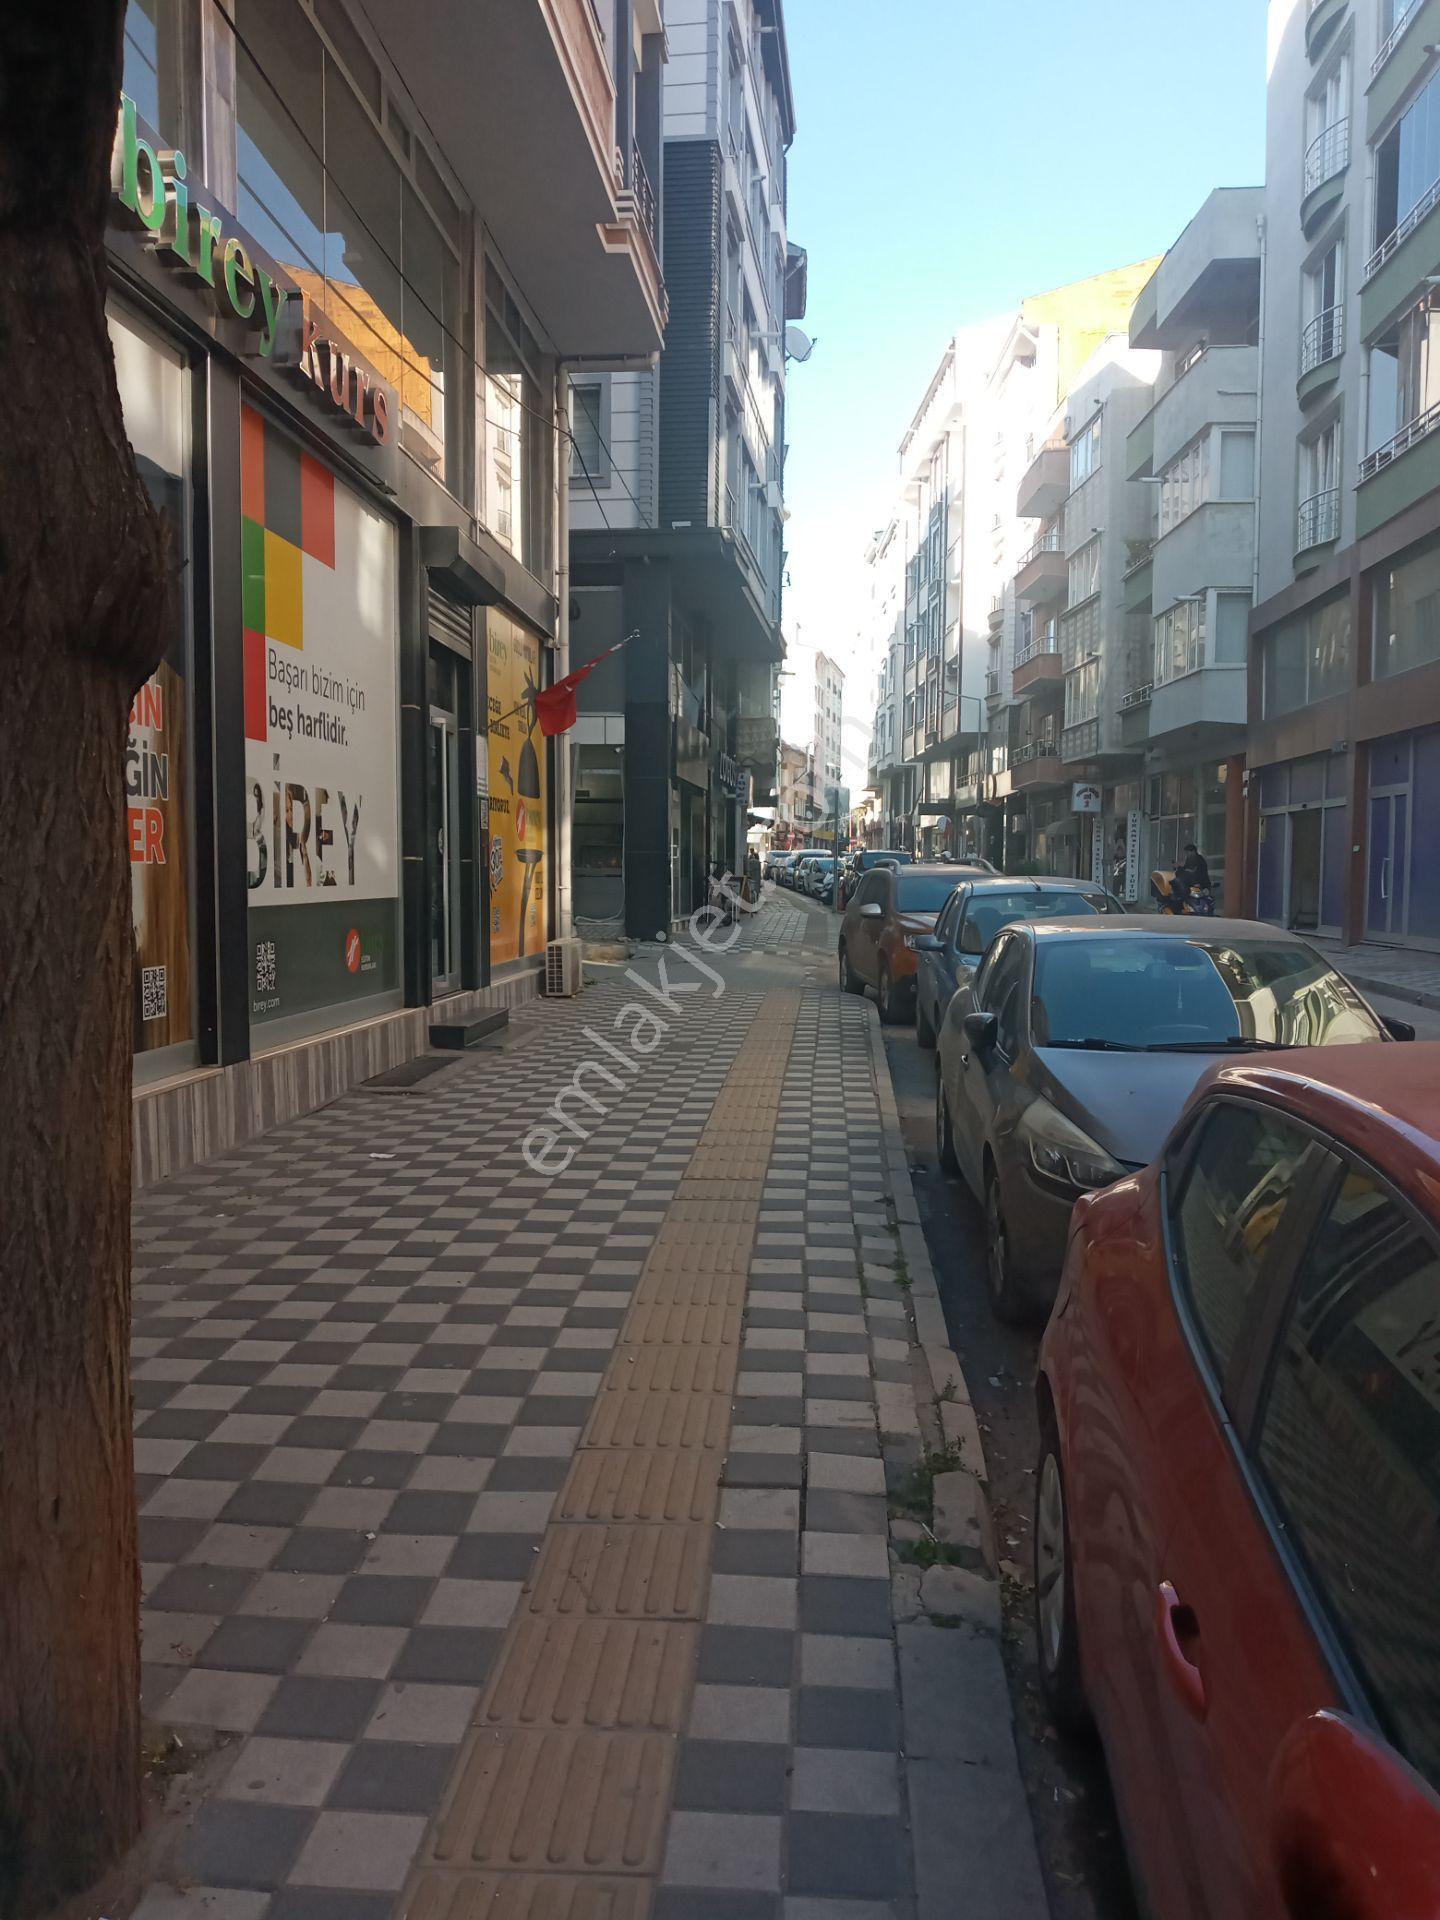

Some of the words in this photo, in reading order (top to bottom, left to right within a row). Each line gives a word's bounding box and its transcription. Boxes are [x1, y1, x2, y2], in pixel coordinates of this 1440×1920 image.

[117, 92, 288, 357] birey
[300, 289, 388, 446] kurs
[268, 648, 308, 694] Başarı
[312, 664, 343, 703] bizim
[346, 678, 365, 715] için
[268, 696, 293, 740] beş
[297, 704, 348, 747] harflidir.
[246, 752, 362, 889] BİREY
